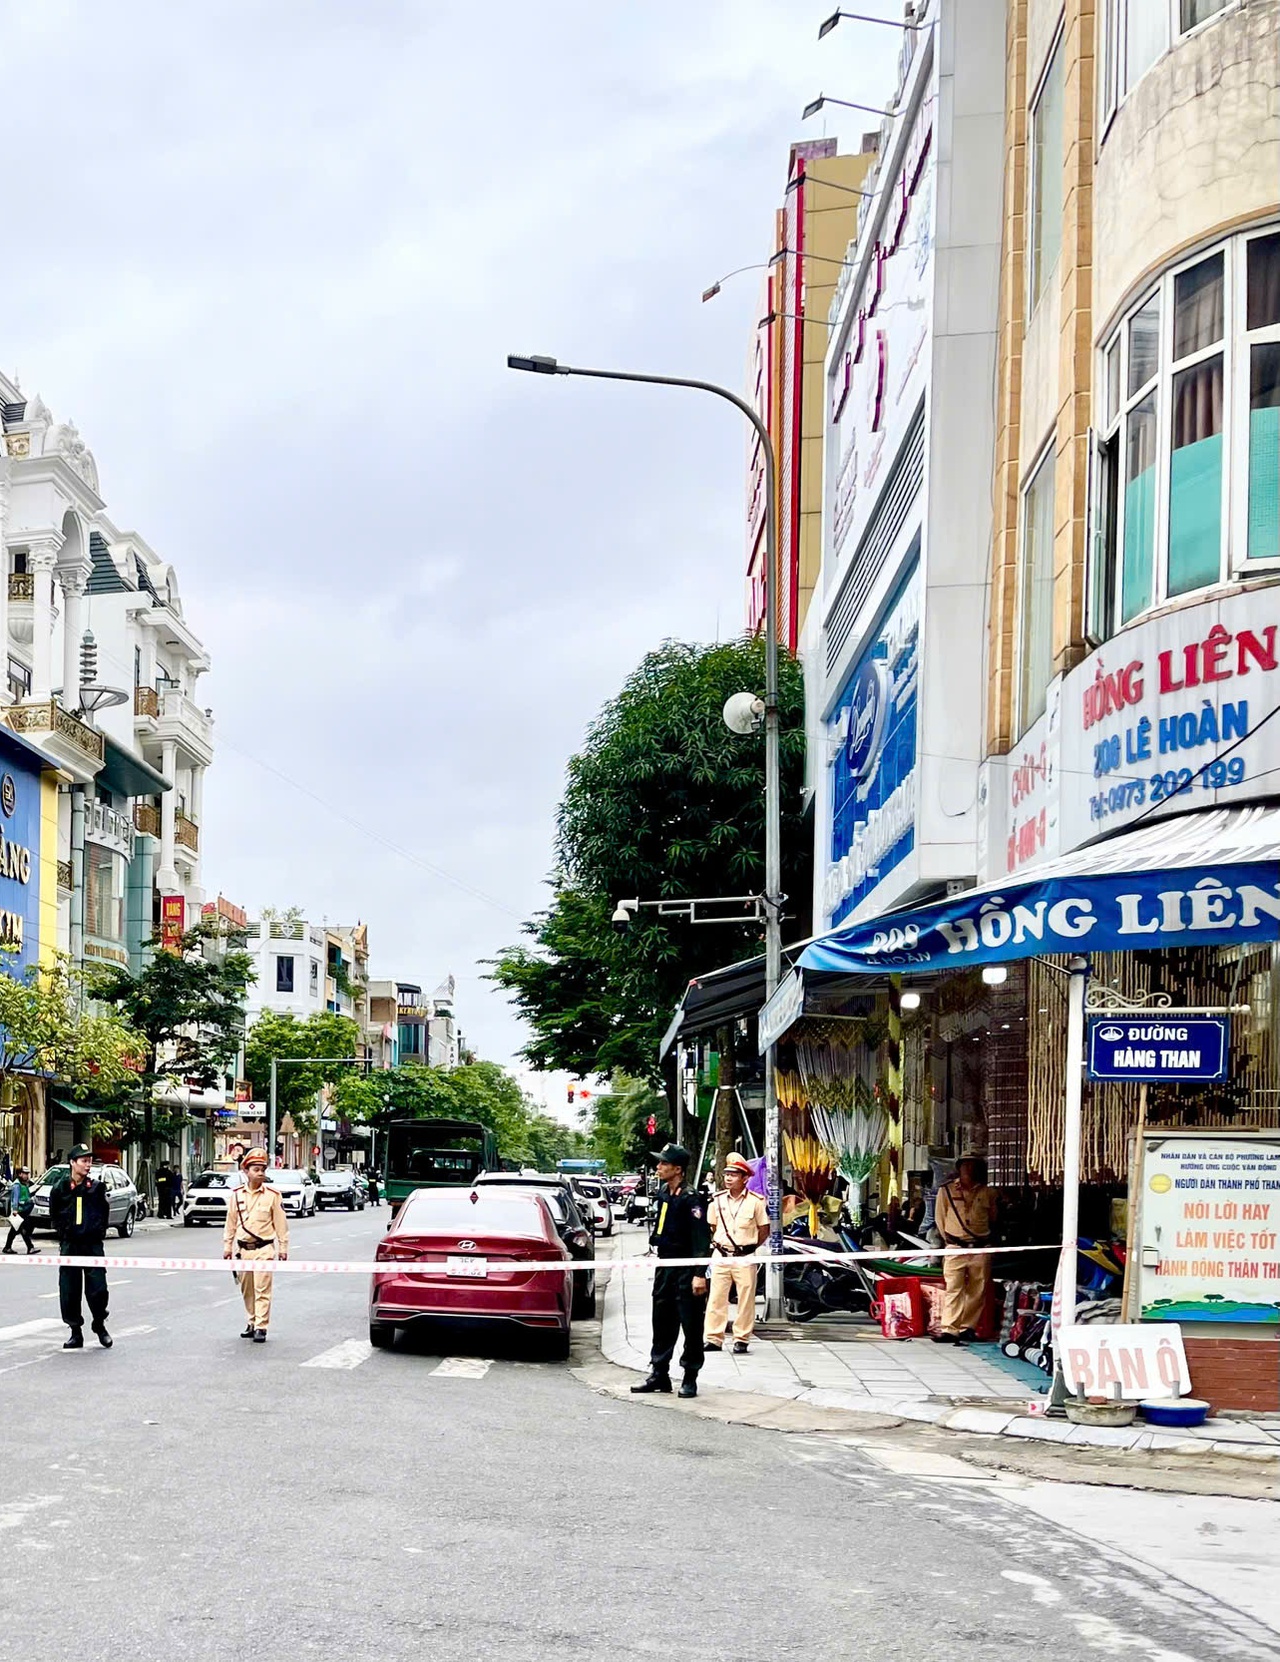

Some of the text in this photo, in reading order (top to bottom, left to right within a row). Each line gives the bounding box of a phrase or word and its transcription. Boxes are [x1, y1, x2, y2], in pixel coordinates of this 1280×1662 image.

[1083, 624, 1279, 731] HỒNG LIÊN
[1126, 716, 1152, 765] LÊ
[1159, 699, 1248, 755] HOÀN
[1150, 767, 1193, 802] 202
[1199, 757, 1246, 790] 199
[935, 876, 1280, 954] HỒNG LIÊN
[1128, 1024, 1188, 1041] ĐƯỜNG
[1113, 1046, 1201, 1068] HÀNG THAN
[1175, 1178, 1198, 1189] NGƯỜI
[1200, 1177, 1217, 1189] DÂN
[1218, 1177, 1242, 1190] THÀNH
[1245, 1177, 1260, 1190] PHỐ
[1184, 1199, 1270, 1220] NÓI LỜI HAY
[1176, 1227, 1277, 1252] LÀM VIỆC TỐT
[1154, 1256, 1188, 1277] HÀNH
[1191, 1257, 1224, 1280] ĐỘNG
[1228, 1258, 1259, 1279] THÂN
[1068, 1338, 1181, 1390] BÁN Ô
